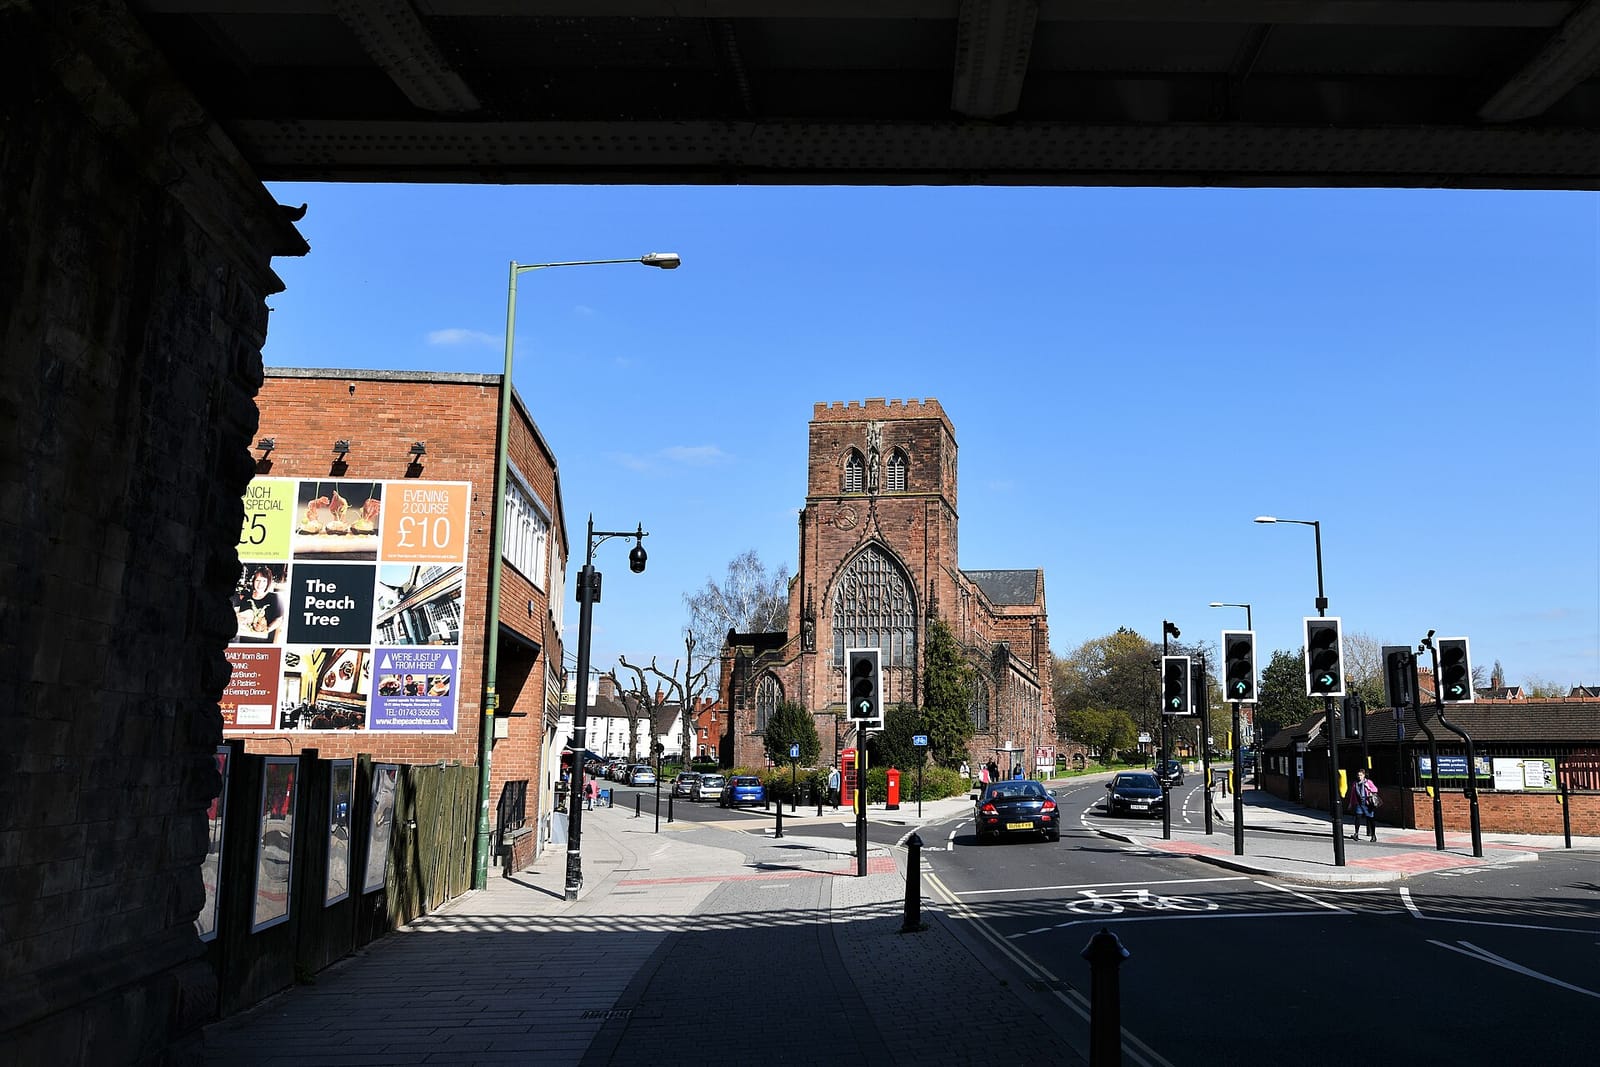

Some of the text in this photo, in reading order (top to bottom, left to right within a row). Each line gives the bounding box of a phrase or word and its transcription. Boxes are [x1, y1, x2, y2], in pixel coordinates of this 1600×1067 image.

[403, 489, 449, 502] EVENING
[245, 499, 284, 511] SPECIAL
[401, 502, 449, 515] 2 COURSE
[396, 515, 451, 549] £10
[305, 578, 337, 593] The
[304, 595, 355, 610] Peach
[303, 612, 341, 626] Tree
[255, 652, 269, 660] 8am
[391, 652, 441, 661] WE'RE JUST UP
[395, 661, 436, 670] FROM HERE!
[229, 688, 249, 696] Evening
[398, 708, 417, 716] 01743
